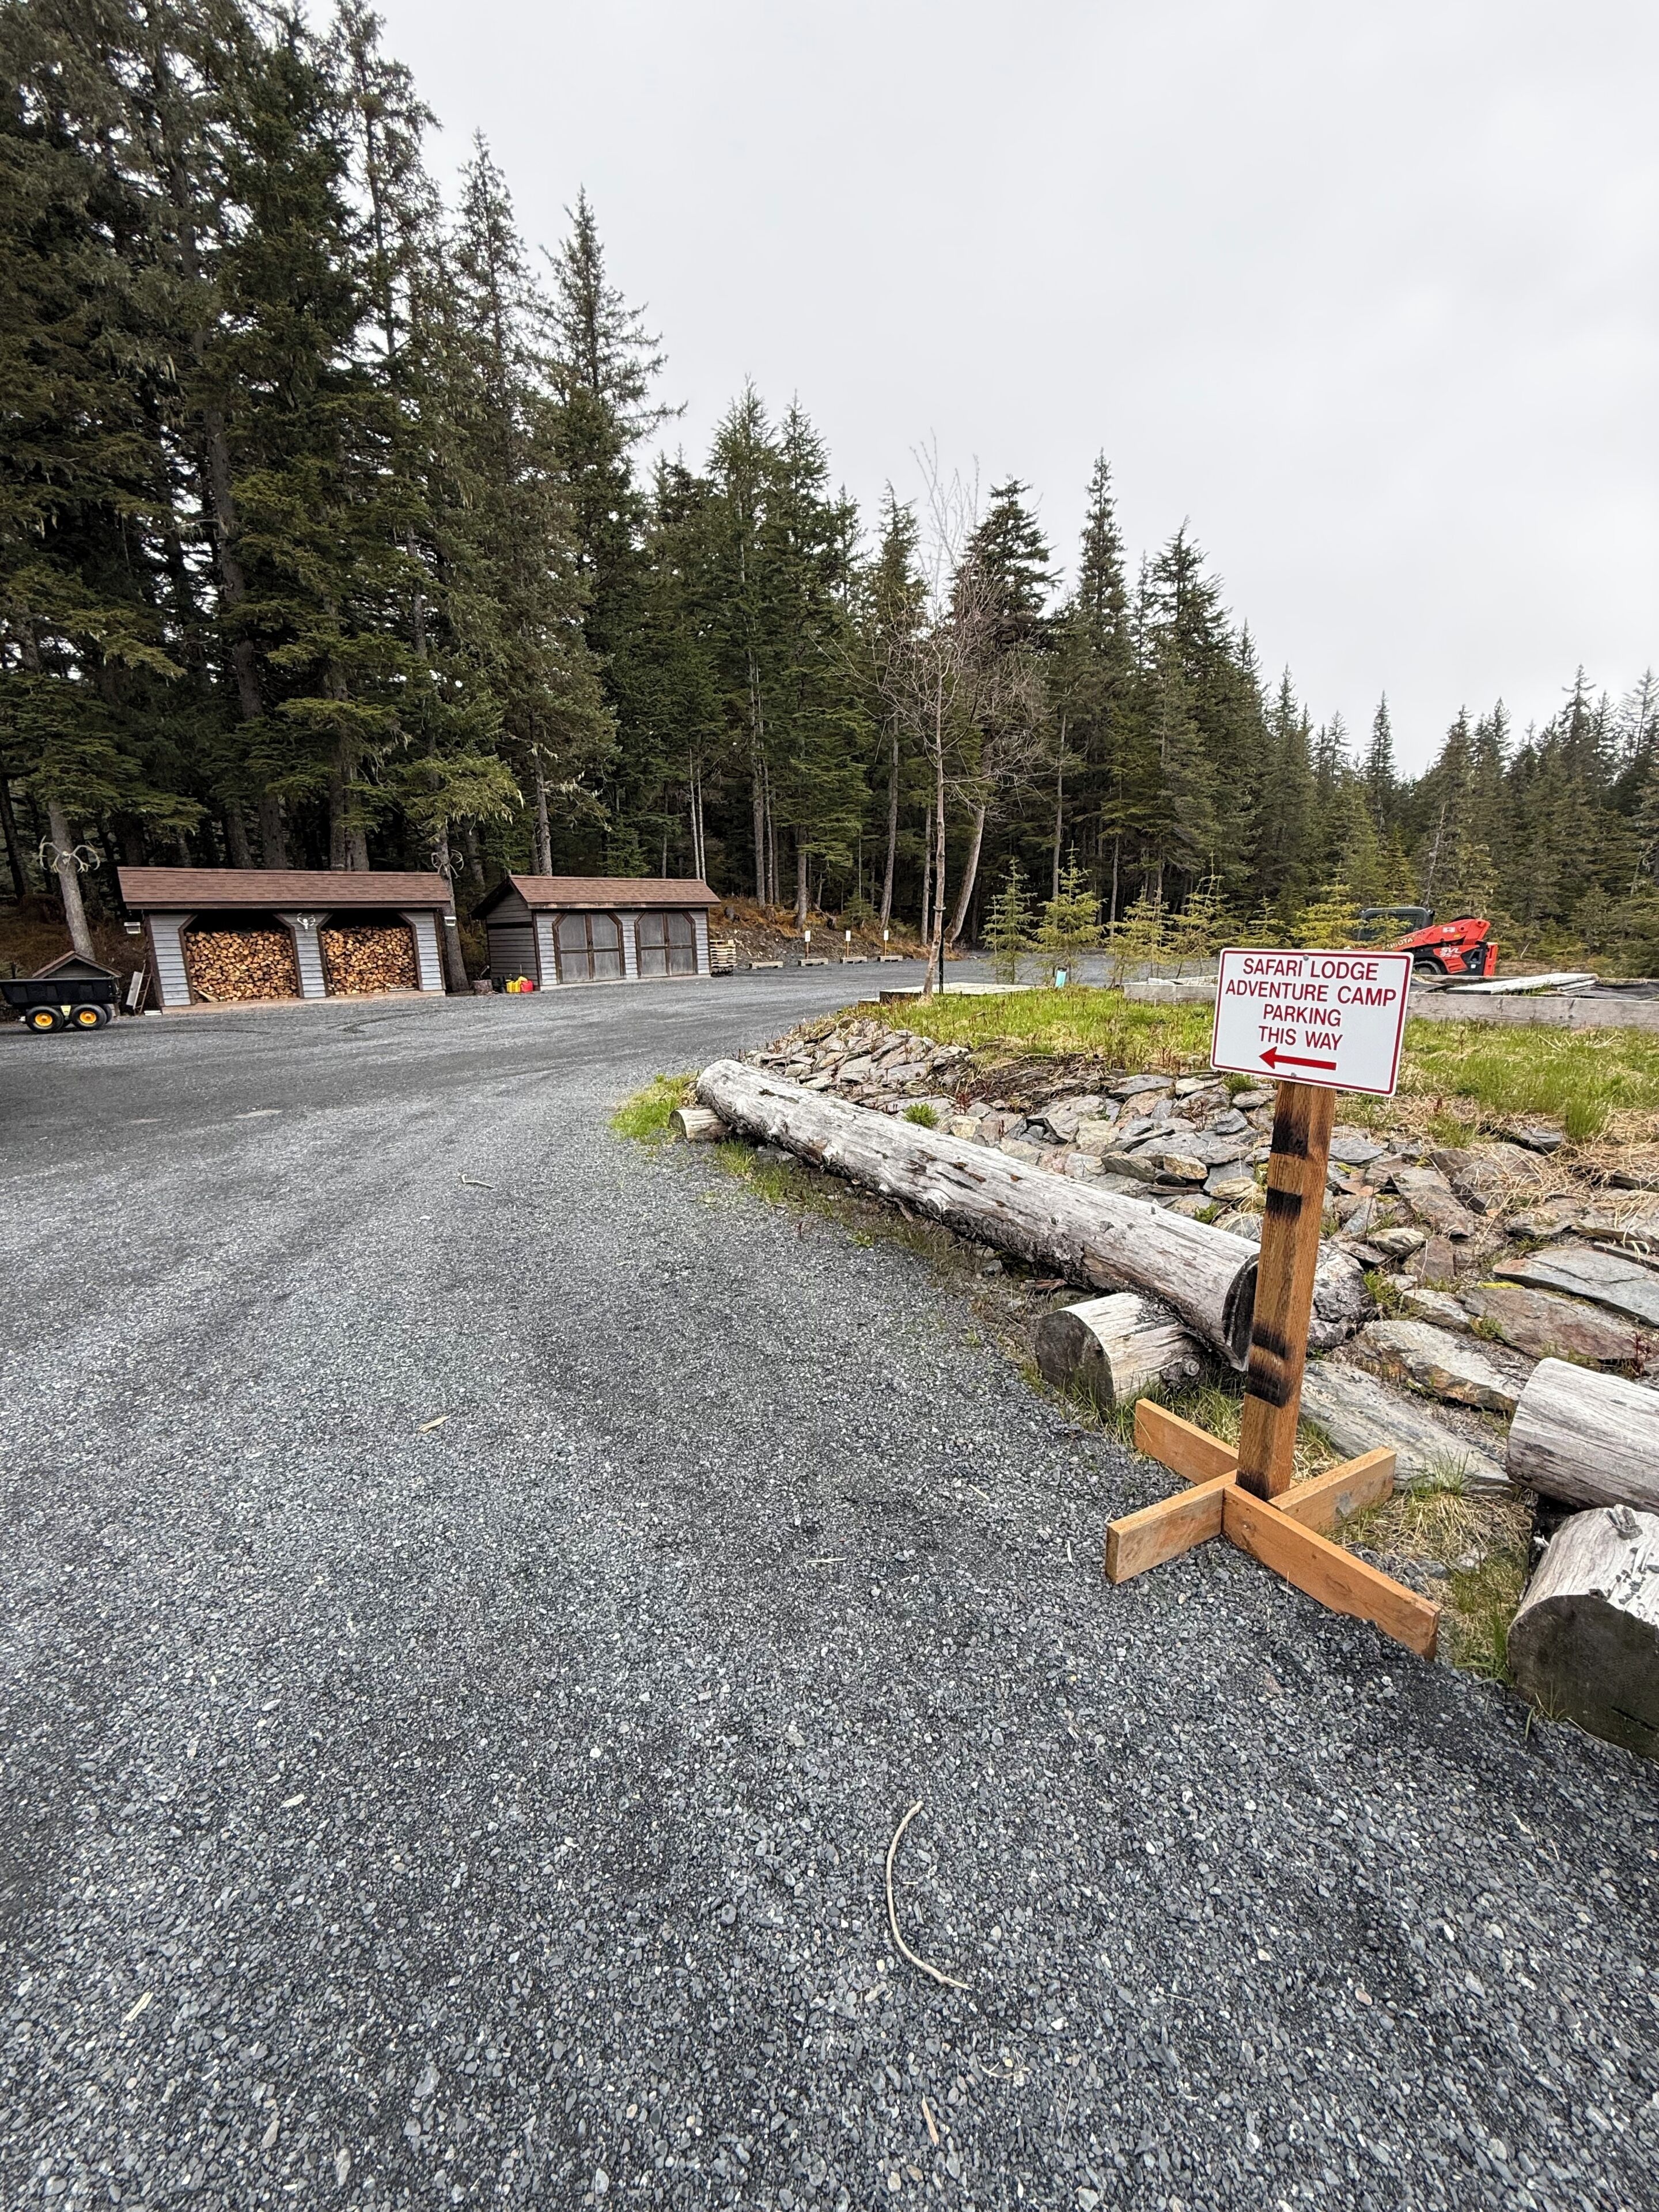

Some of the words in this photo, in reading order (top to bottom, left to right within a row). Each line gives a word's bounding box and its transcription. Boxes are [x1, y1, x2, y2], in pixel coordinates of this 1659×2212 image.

[1243, 958, 1303, 976] SAFARI
[1310, 961, 1379, 980] LODGE
[1225, 980, 1329, 1002] ADVENTURE
[1337, 986, 1397, 1007] CAMP
[1263, 1003, 1342, 1027] PARKING
[1259, 1025, 1297, 1046] THIS
[1305, 1031, 1343, 1051] WAY
